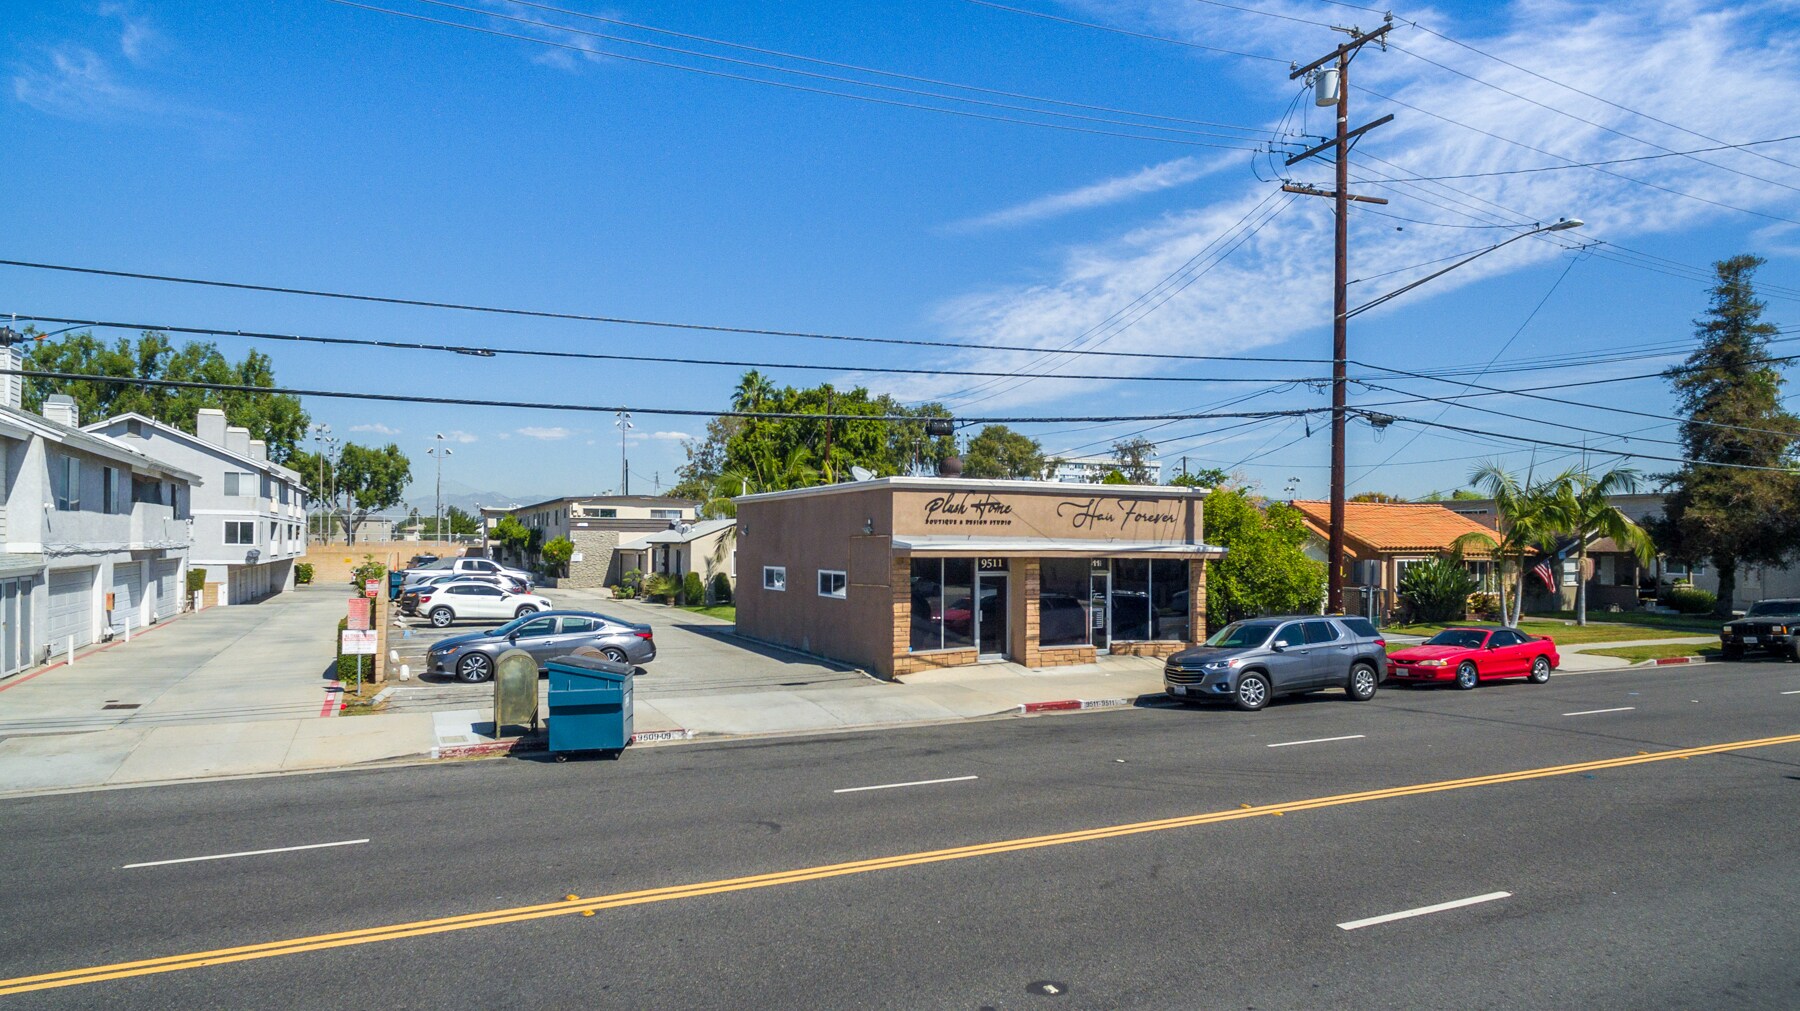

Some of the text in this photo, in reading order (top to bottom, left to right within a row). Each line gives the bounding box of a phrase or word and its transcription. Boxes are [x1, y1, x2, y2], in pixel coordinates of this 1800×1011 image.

[925, 492, 1012, 520] Plush Home
[1057, 498, 1177, 531] Hair Forever
[981, 558, 1002, 569] 9511
